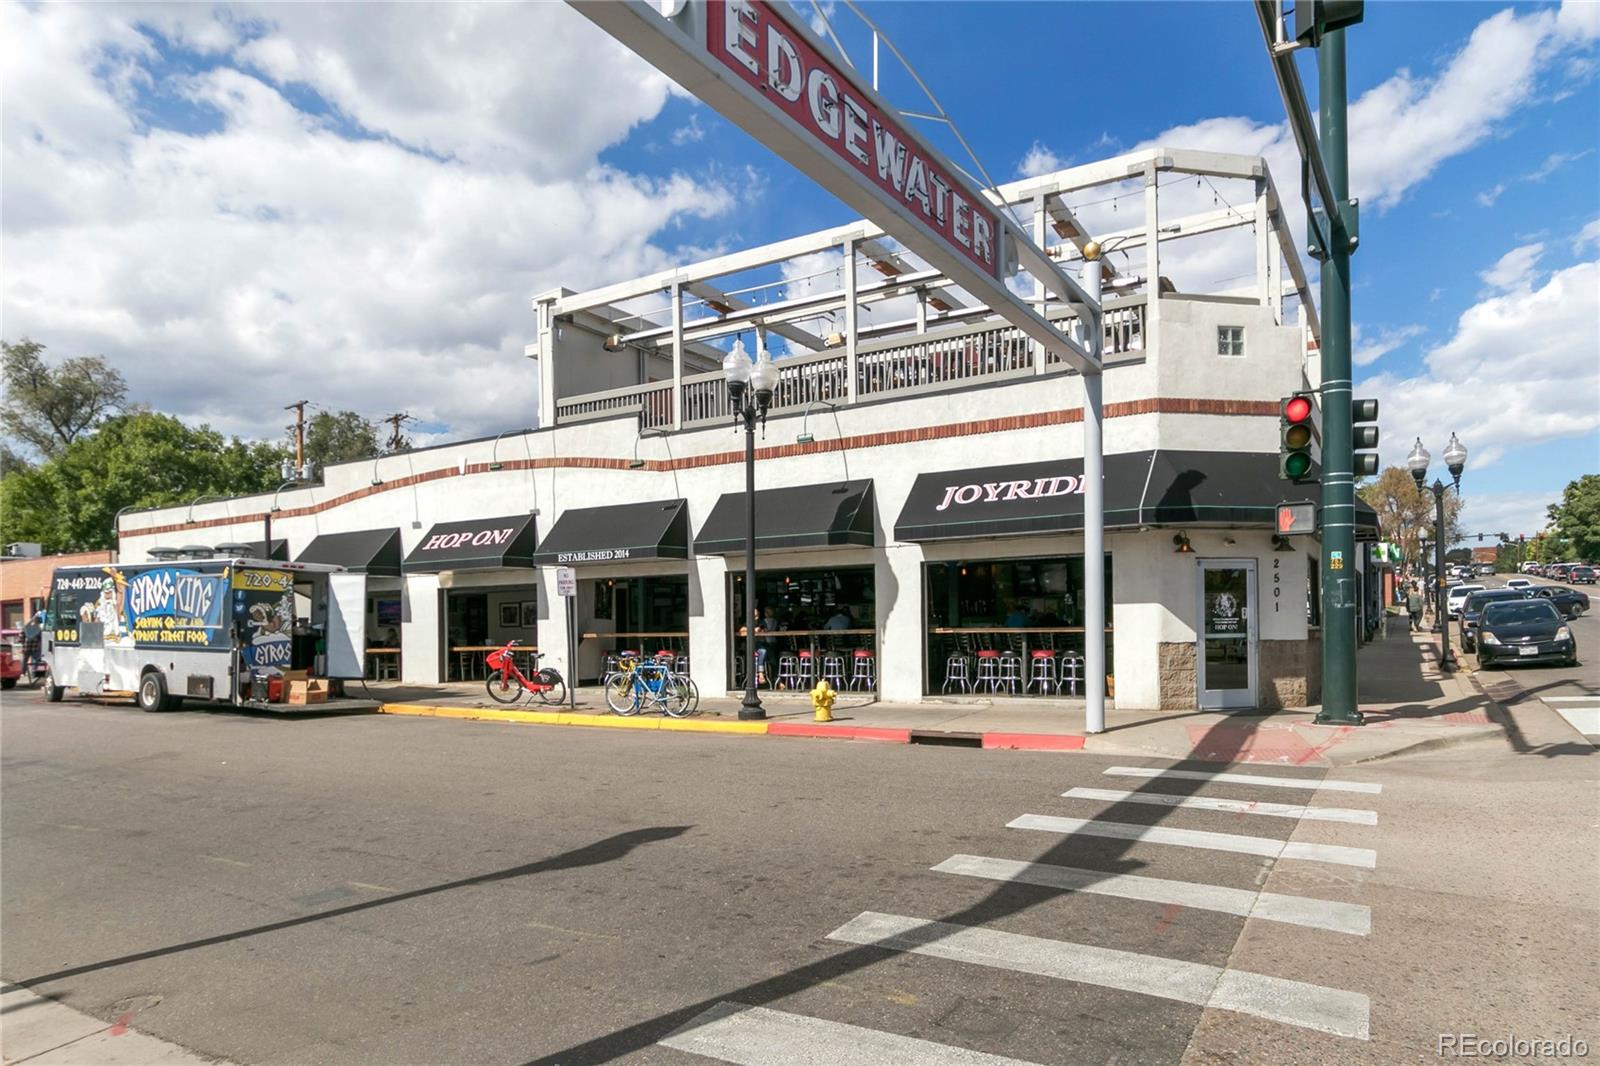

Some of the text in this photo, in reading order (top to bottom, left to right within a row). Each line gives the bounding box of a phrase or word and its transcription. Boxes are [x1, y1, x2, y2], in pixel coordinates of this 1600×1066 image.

[725, 0, 995, 266] EDGEWATER
[422, 528, 514, 550] HOP ON!
[558, 549, 629, 562] ESTABLISHED 2014
[255, 643, 291, 664] GYROS
